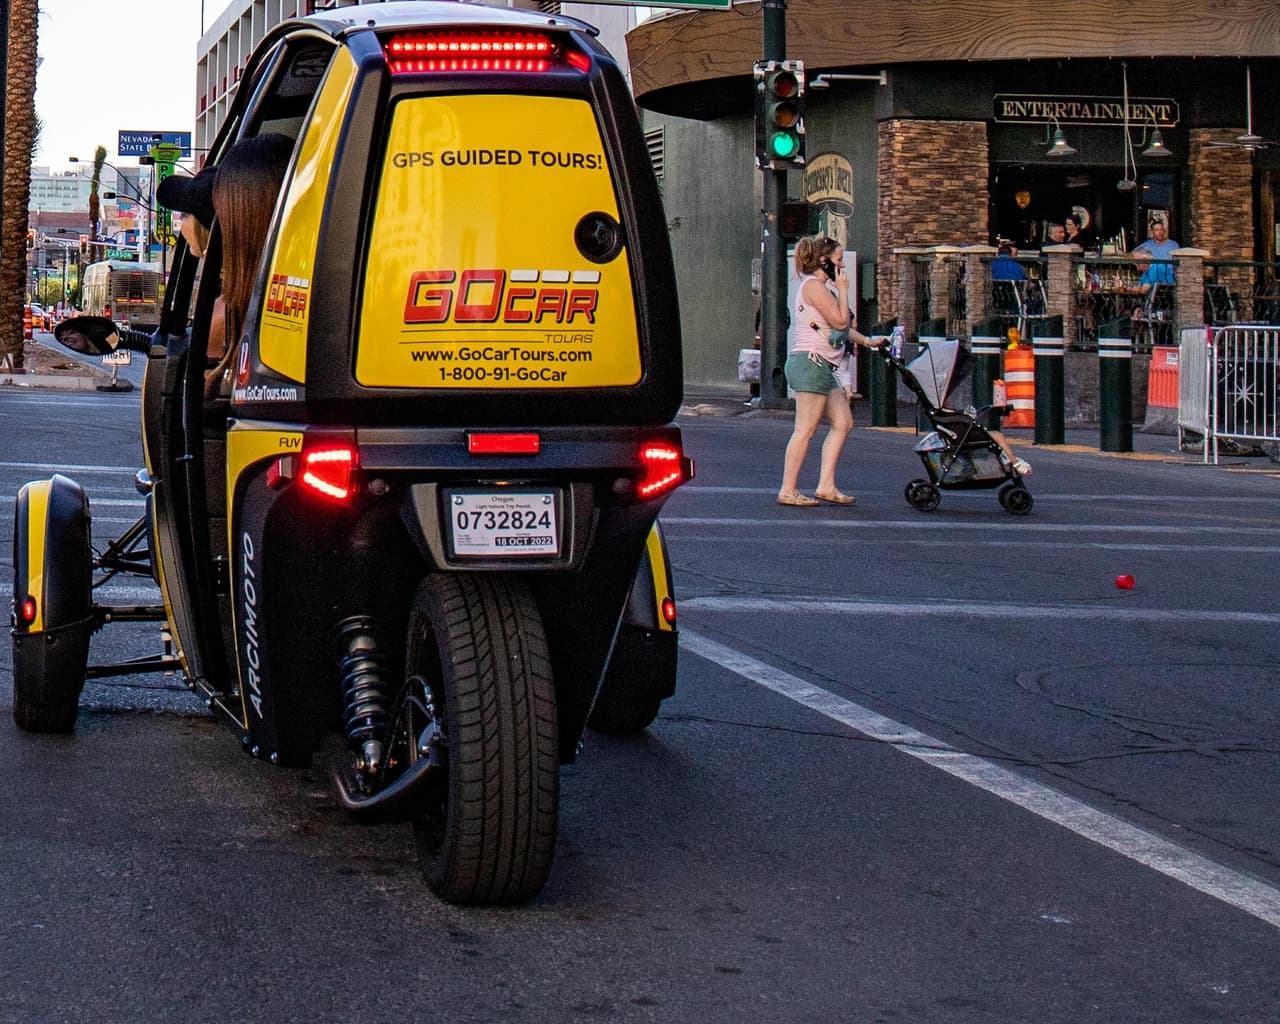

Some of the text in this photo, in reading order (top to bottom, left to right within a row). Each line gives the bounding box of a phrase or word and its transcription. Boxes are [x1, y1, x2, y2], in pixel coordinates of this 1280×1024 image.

[1001, 100, 1170, 121] ENTERTAINMENT
[120, 135, 154, 143] NEVADA
[120, 144, 144, 152] STATE
[392, 150, 603, 170] GPS GUIDED TOURS!
[107, 250, 133, 258] CARSON
[545, 334, 593, 343] TOURS
[411, 347, 593, 362] www.GoCarTours.com
[439, 367, 567, 382] 1-800-91-GoCar
[279, 437, 302, 448] FUV
[457, 510, 552, 530] 0732824
[497, 538, 507, 546] 18
[508, 538, 528, 546] OCT
[530, 537, 552, 545] 2022
[242, 532, 263, 720] ARCIMOTO
